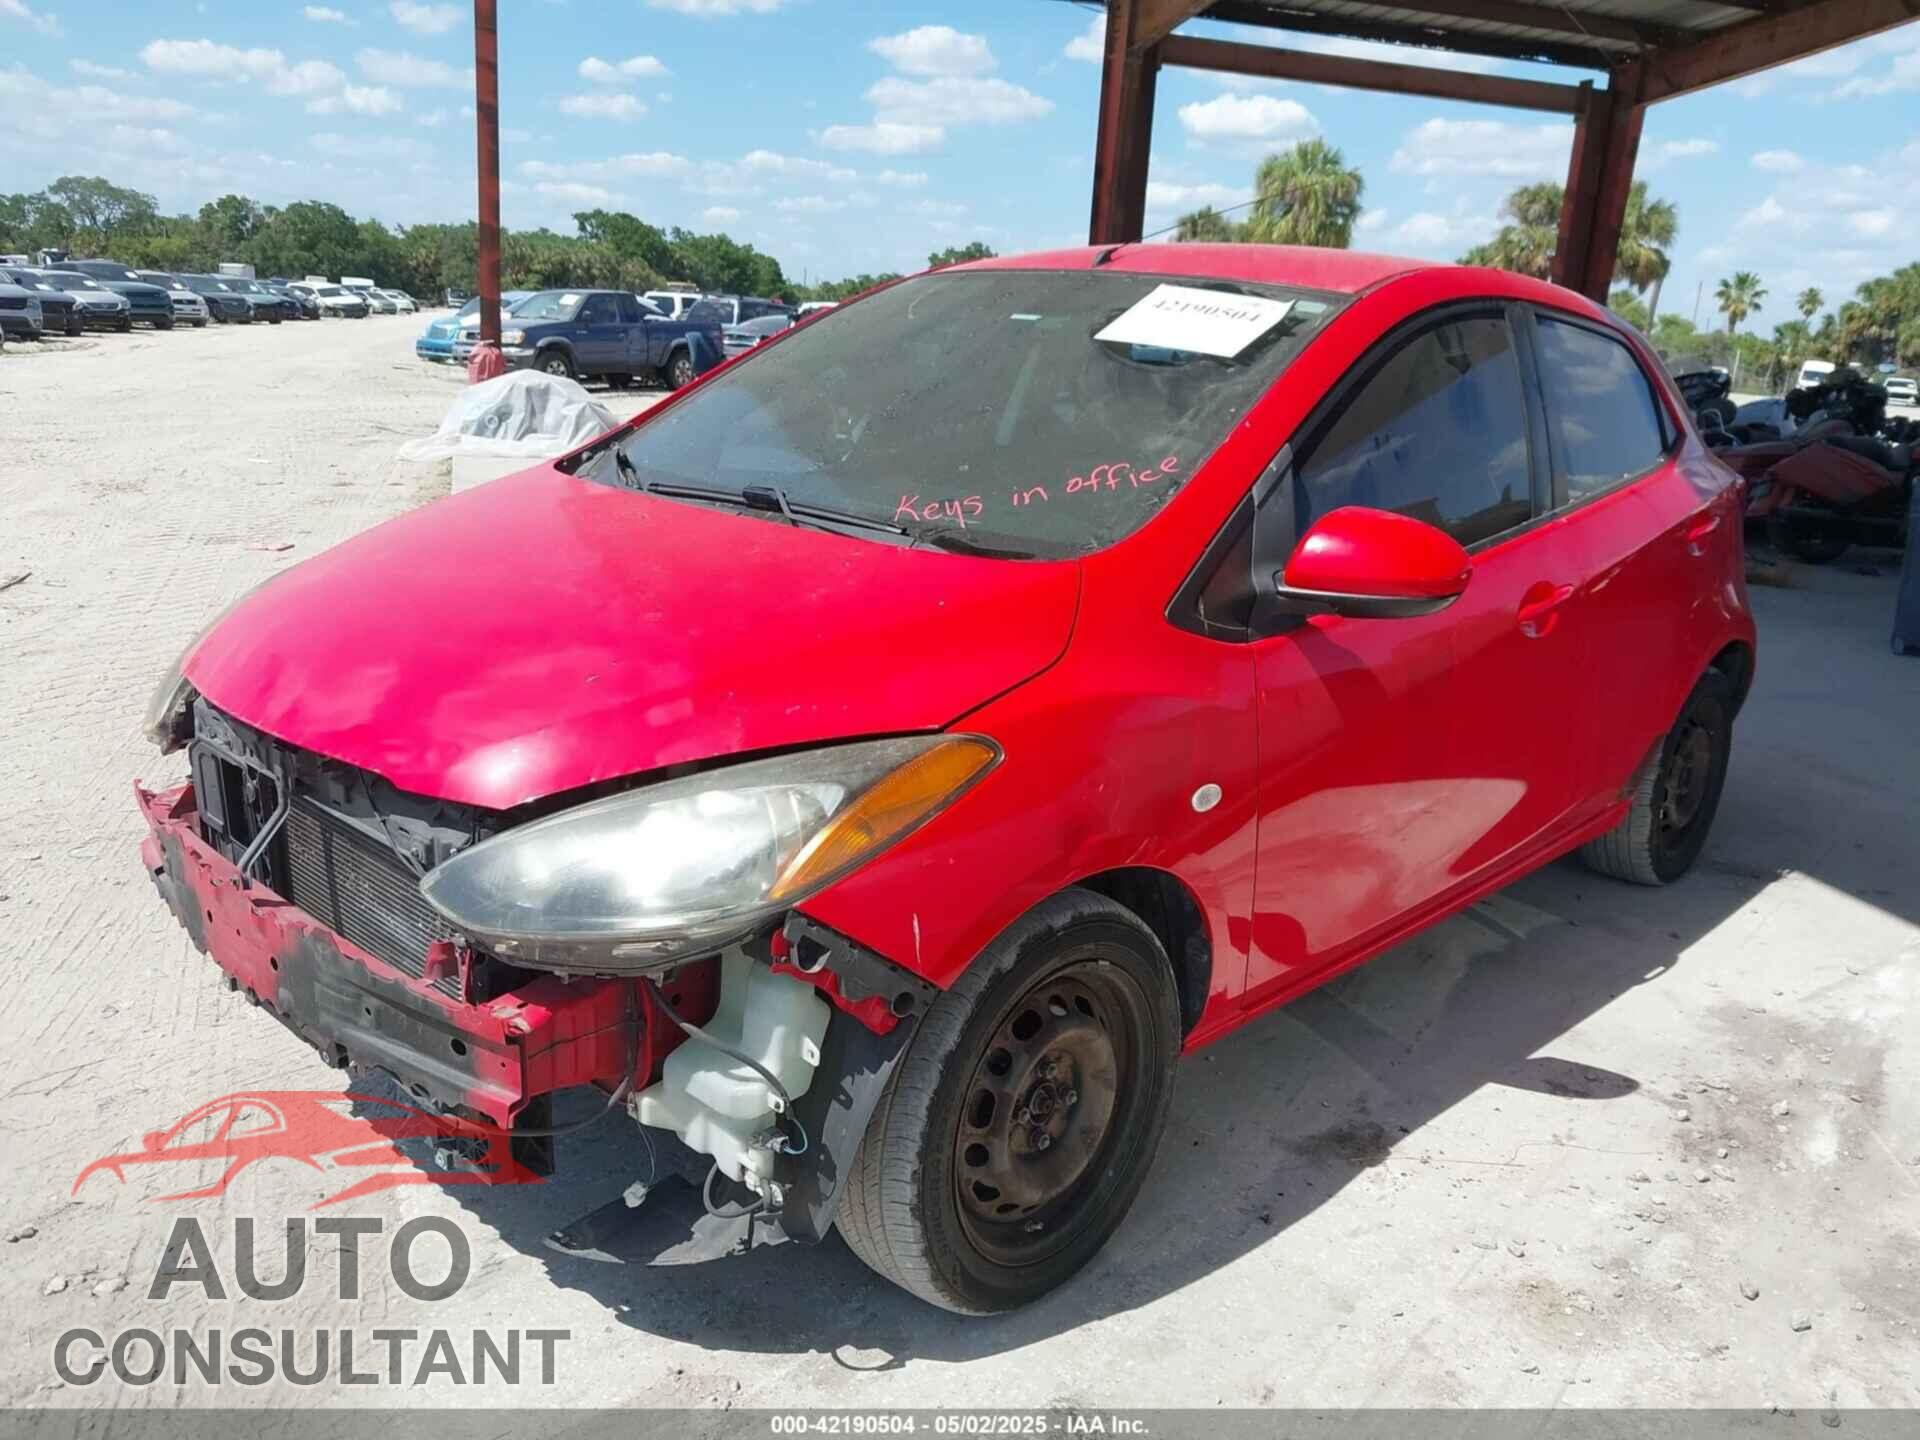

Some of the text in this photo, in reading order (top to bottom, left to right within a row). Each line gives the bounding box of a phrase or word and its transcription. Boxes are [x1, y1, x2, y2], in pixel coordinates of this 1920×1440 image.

[894, 455, 1180, 529] Keys in office
